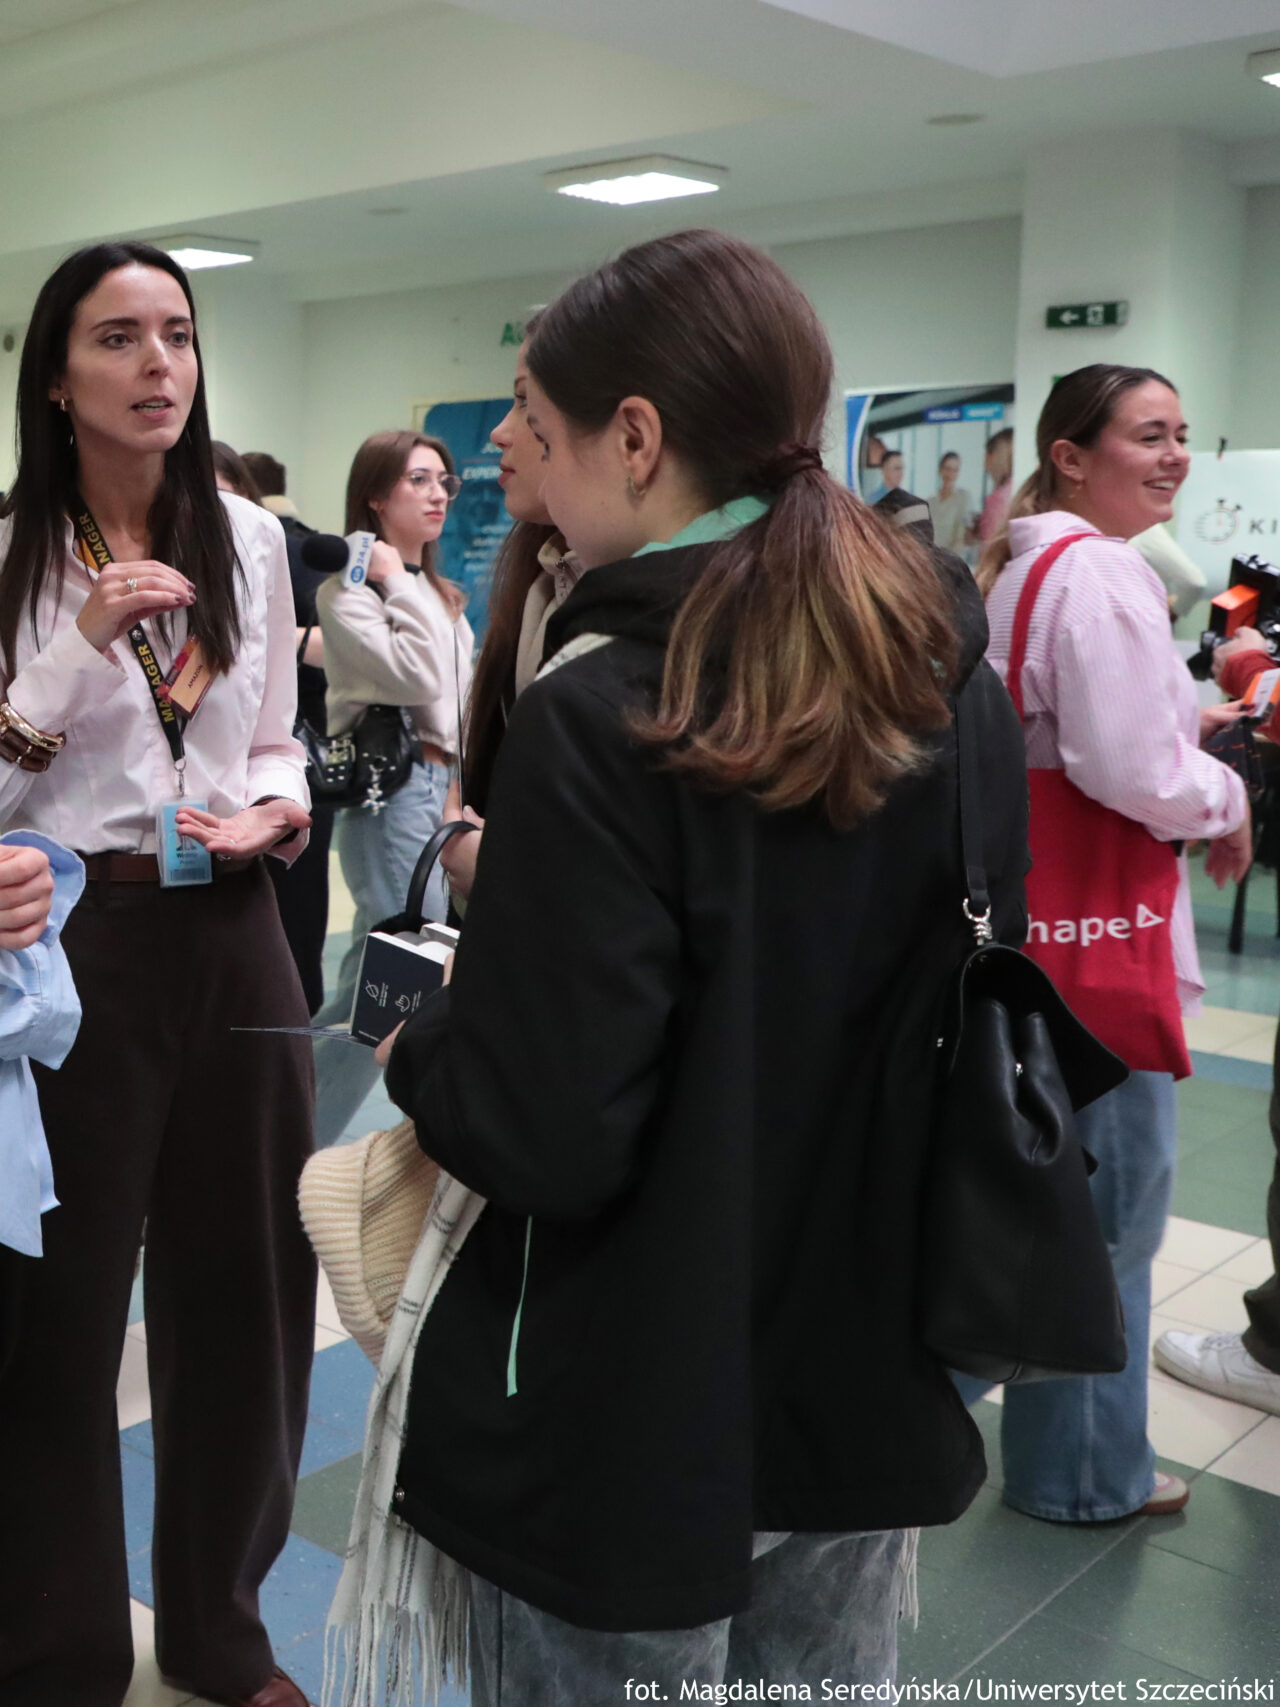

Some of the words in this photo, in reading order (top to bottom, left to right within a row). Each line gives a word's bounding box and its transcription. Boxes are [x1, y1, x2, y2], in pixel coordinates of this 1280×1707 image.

[462, 465, 503, 480] EXPER
[78, 512, 113, 566] NAGER
[137, 643, 176, 725] MAAGER
[1025, 913, 1132, 947] hape
